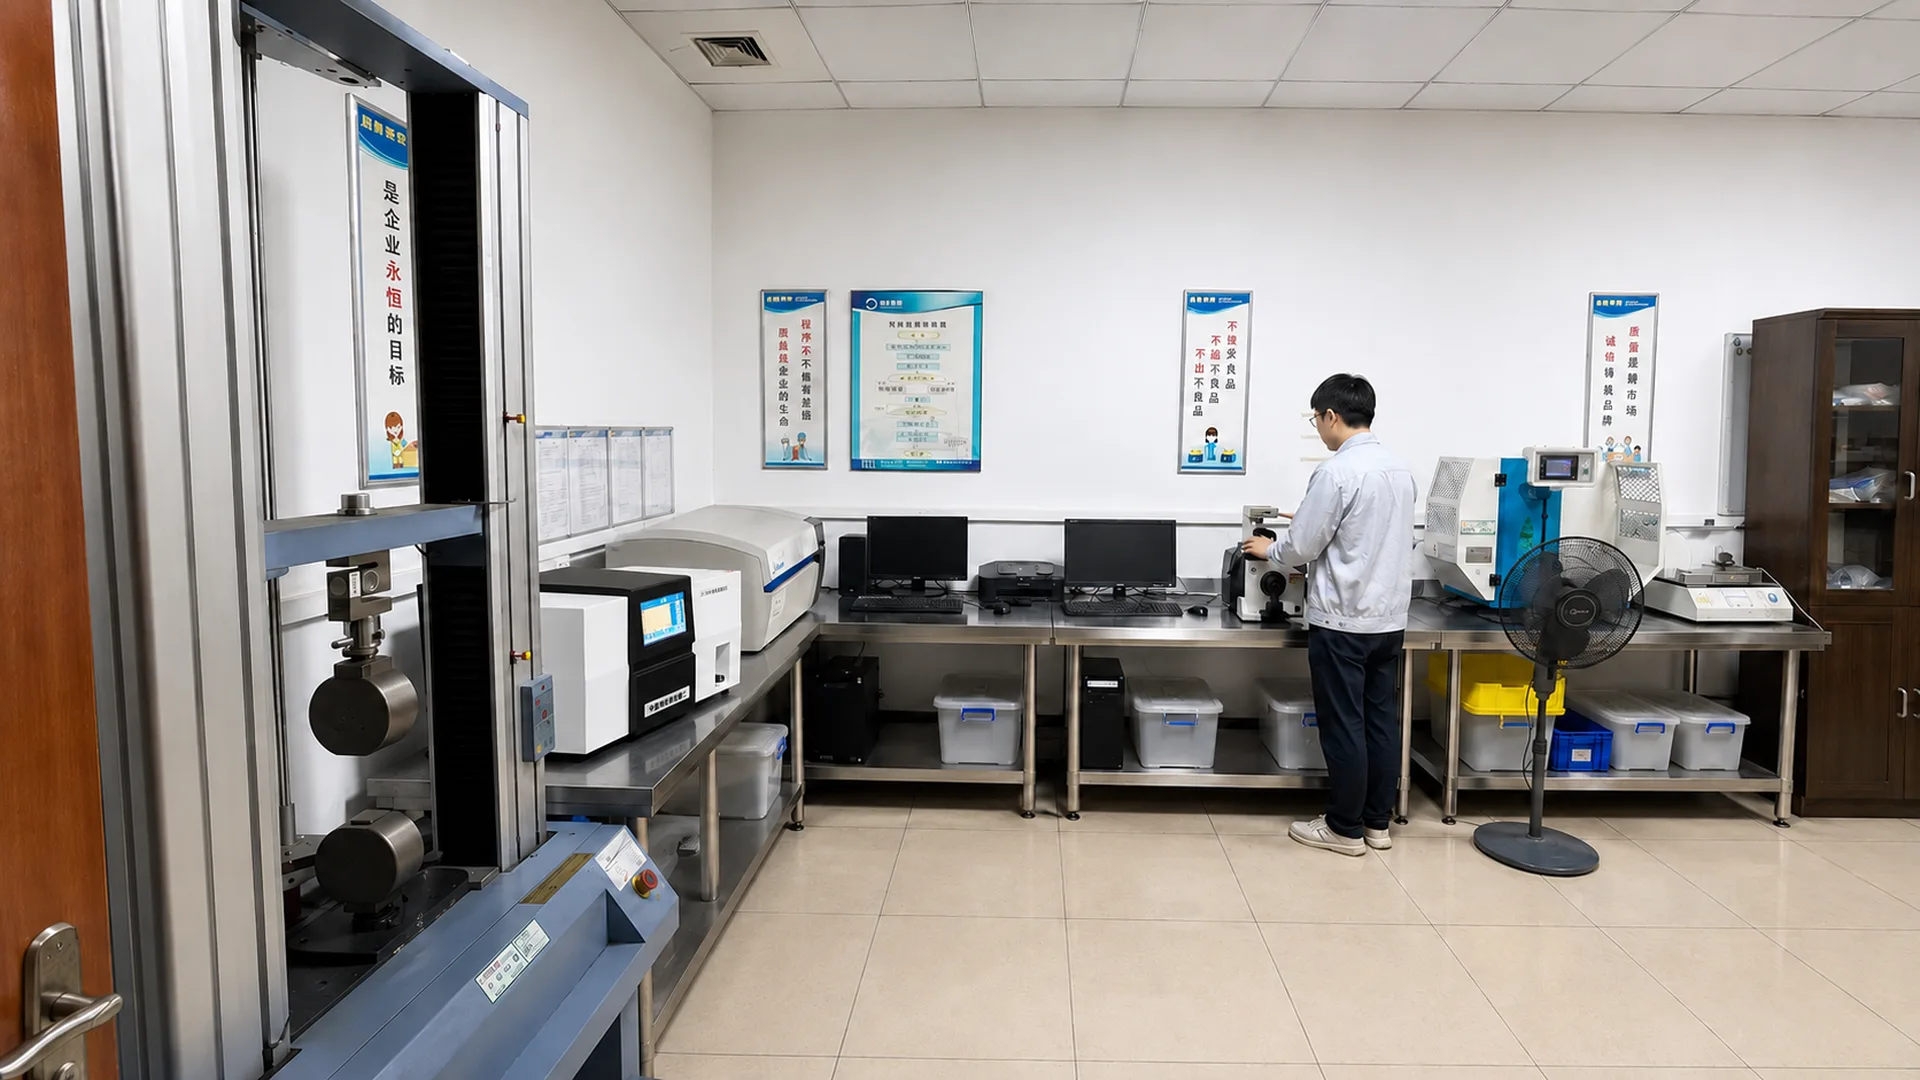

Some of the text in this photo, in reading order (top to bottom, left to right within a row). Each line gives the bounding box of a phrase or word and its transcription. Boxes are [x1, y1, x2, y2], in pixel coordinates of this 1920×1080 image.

[383, 180, 405, 385] 是企业永恒的目标
[1209, 335, 1221, 403] 不不良品
